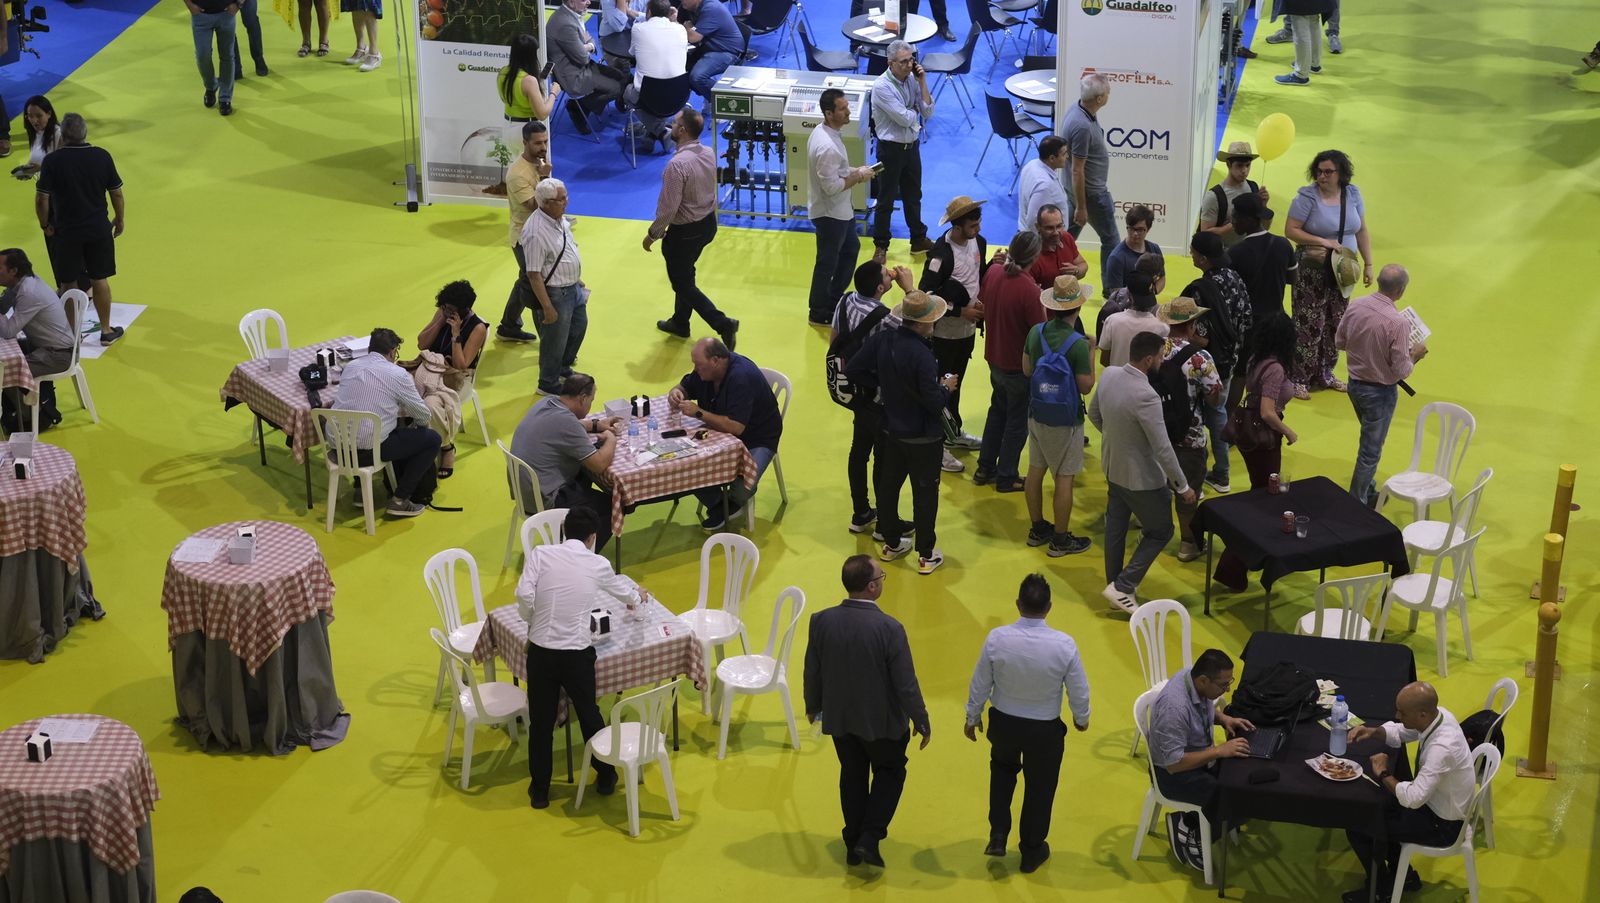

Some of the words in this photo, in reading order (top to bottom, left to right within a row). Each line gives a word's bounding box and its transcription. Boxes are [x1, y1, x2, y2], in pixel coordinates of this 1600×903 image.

[1106, 0, 1173, 12] Guadalfeo
[453, 49, 482, 57] Calidad
[1101, 127, 1170, 151] COM
